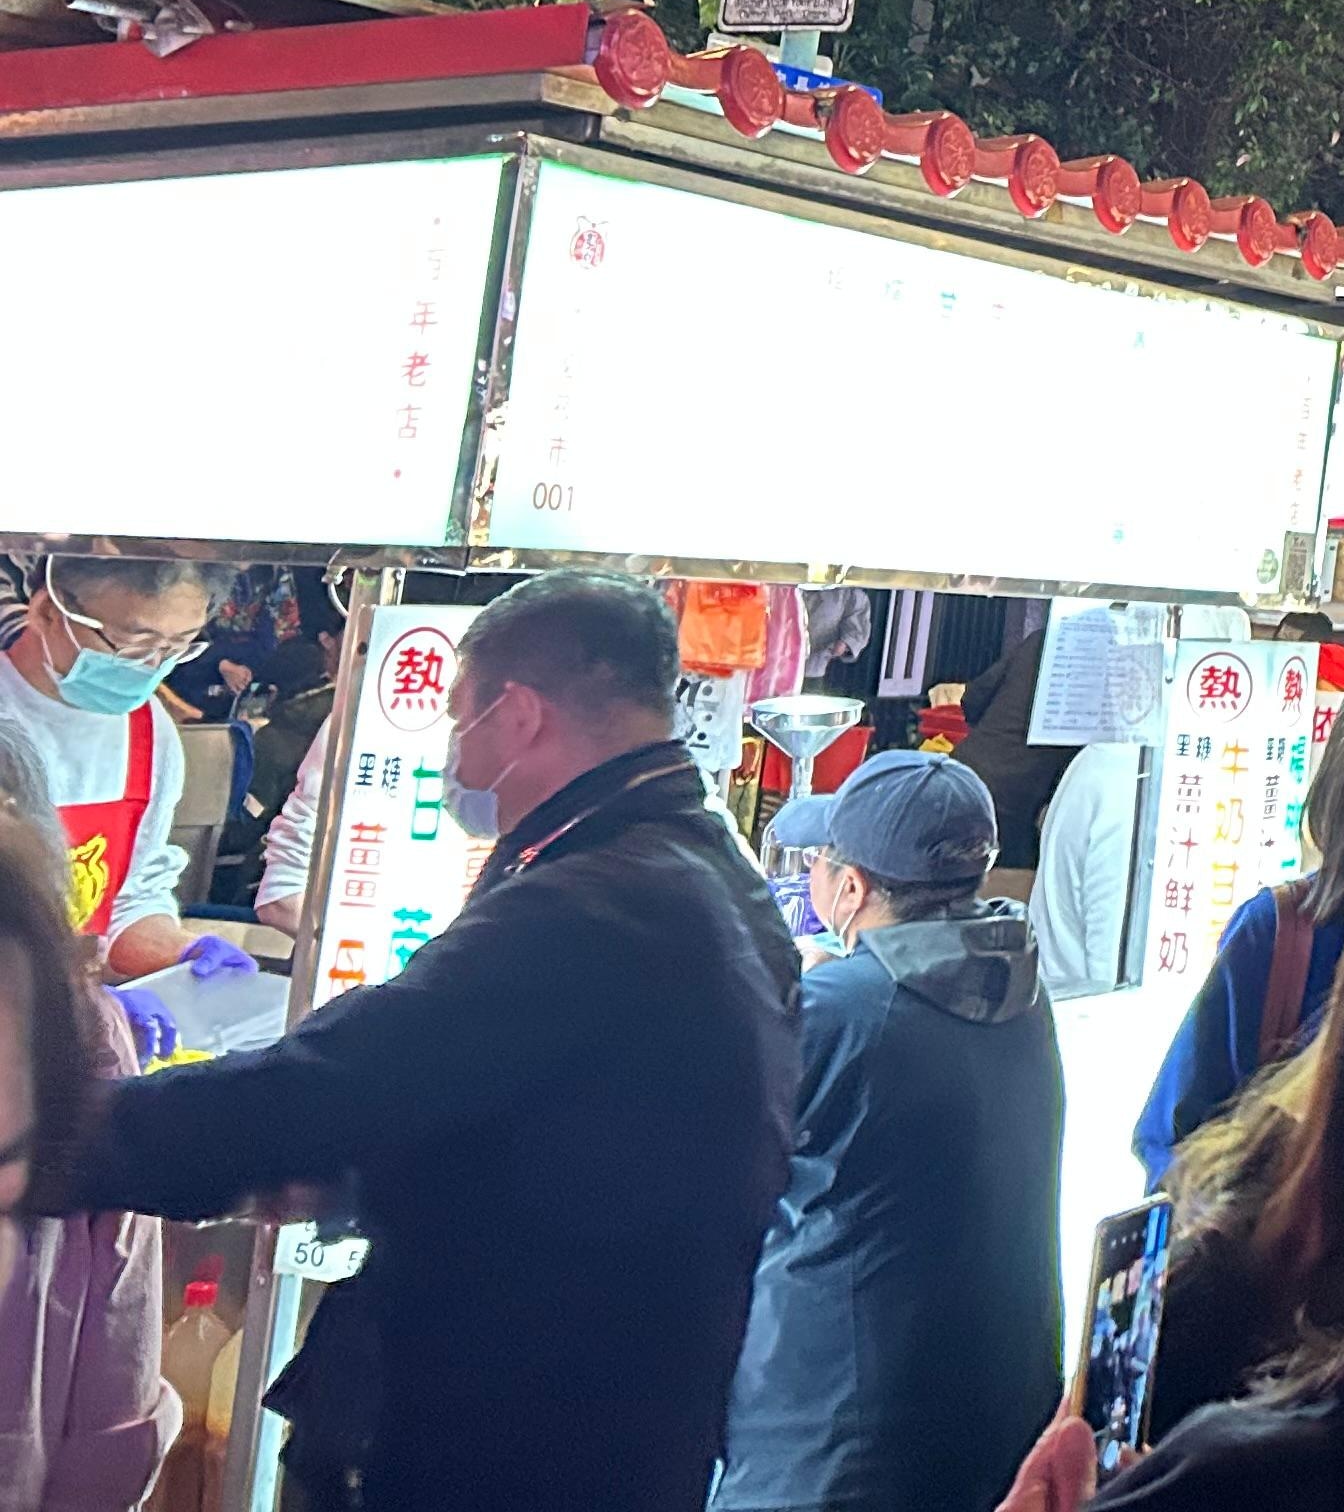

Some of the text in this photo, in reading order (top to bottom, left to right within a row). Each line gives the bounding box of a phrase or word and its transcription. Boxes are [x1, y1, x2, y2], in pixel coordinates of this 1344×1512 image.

[533, 481, 573, 512] 001
[390, 646, 446, 712] 熱
[1200, 665, 1242, 712] 熱
[1282, 668, 1303, 713] 熱
[294, 1242, 325, 1268] 50
